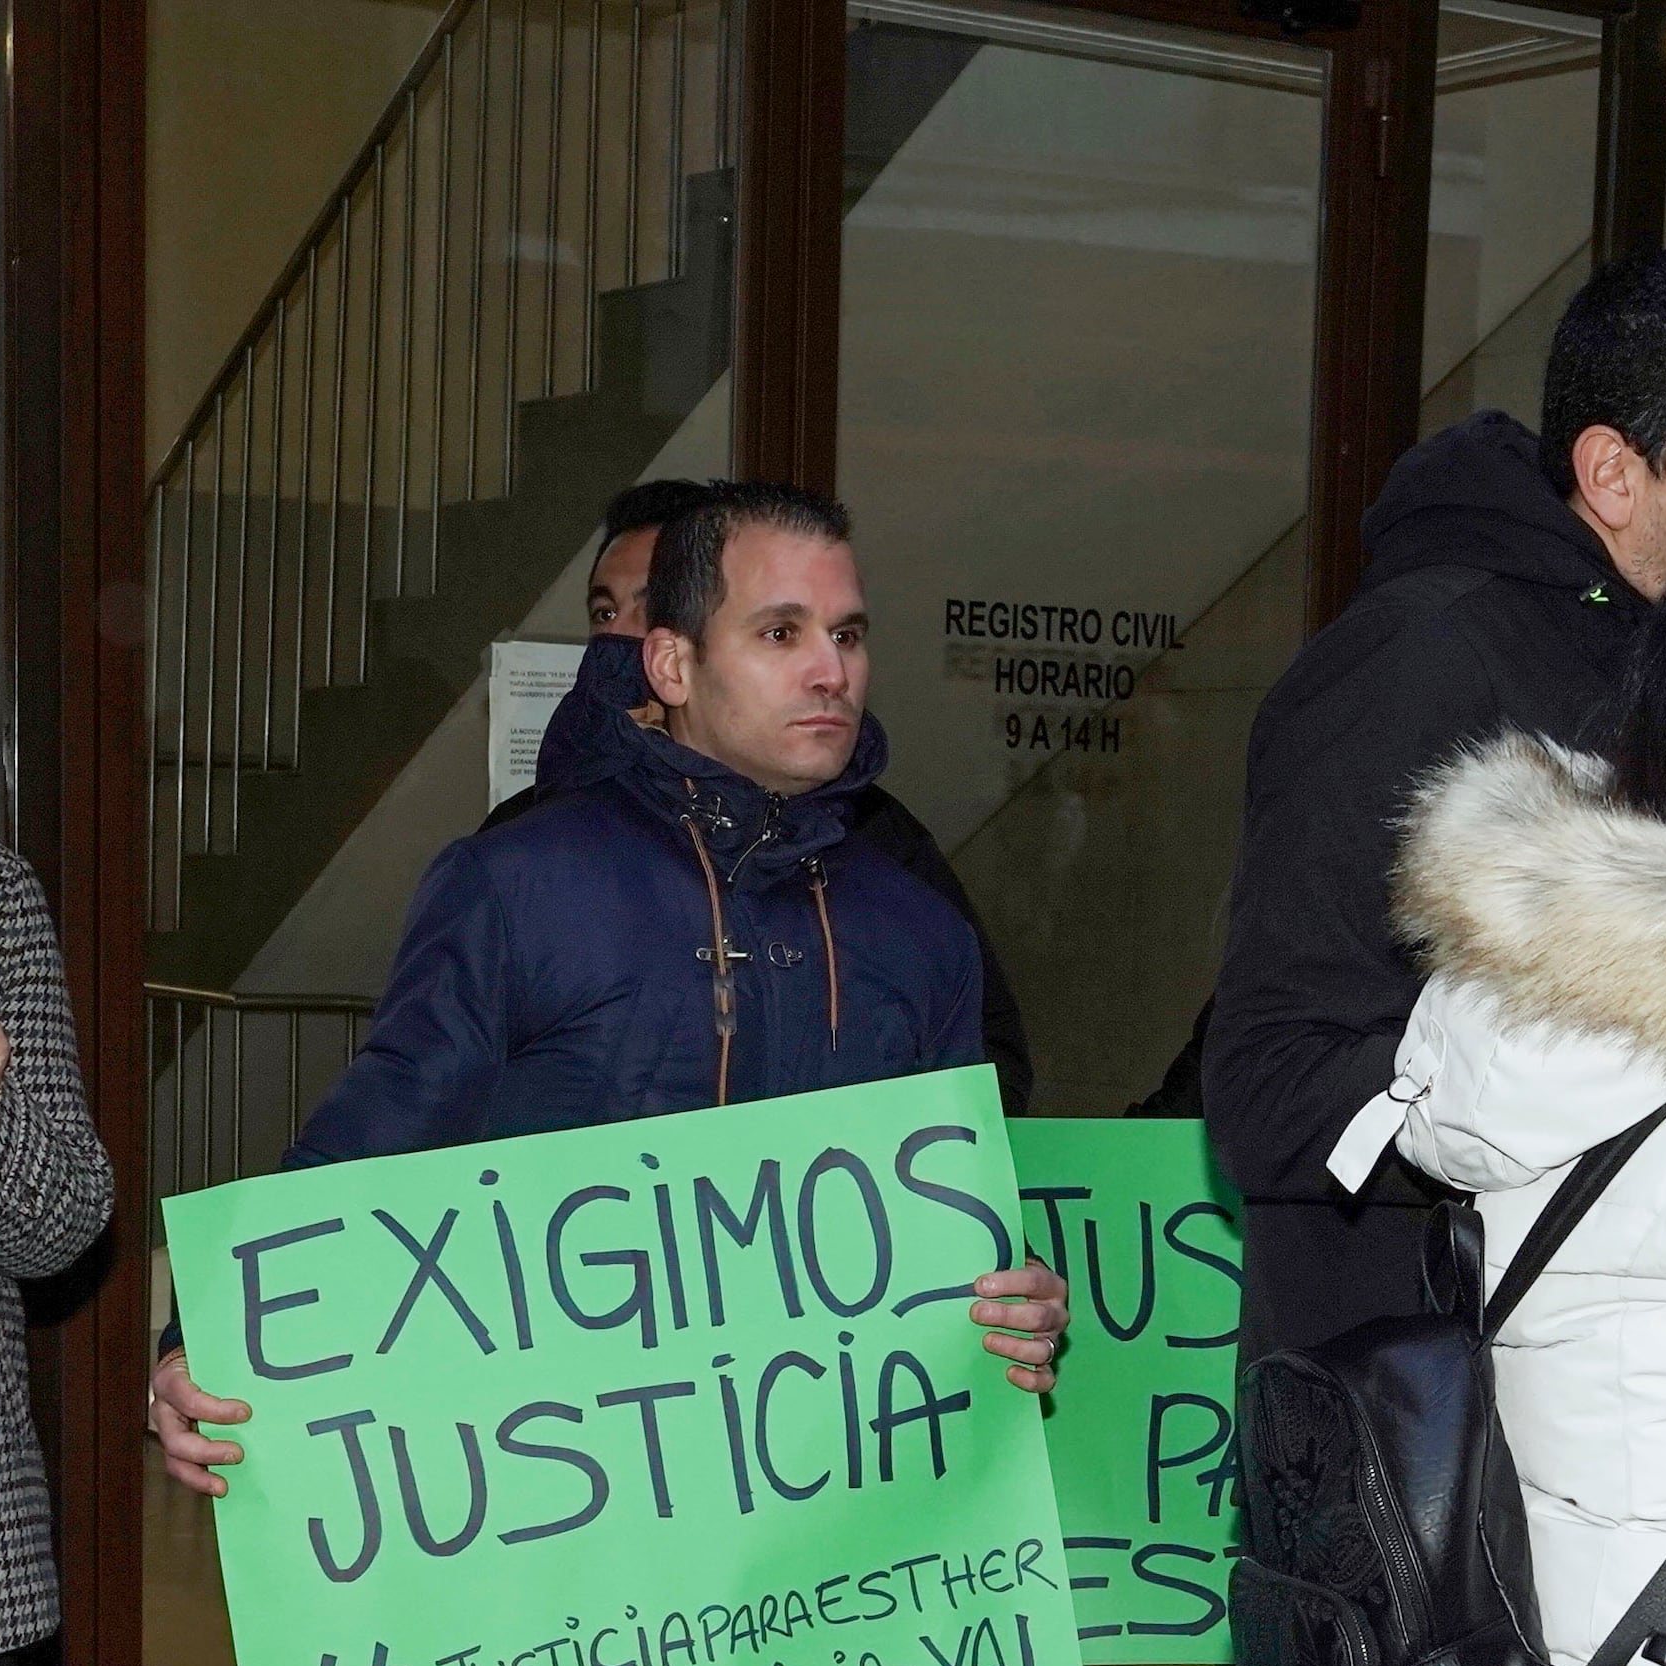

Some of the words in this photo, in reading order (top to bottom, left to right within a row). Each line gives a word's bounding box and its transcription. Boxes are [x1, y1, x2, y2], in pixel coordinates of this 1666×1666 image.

[945, 598, 1102, 645] REGISTRO
[1112, 610, 1185, 649] CIVIL
[994, 657, 1134, 701] HORARIO
[1005, 713, 1022, 749] 9
[1030, 715, 1051, 750] A
[1060, 715, 1090, 752] 14
[1101, 717, 1120, 753] H
[305, 1330, 971, 1584] JUSTICIA
[1063, 1536, 1245, 1639] ES
